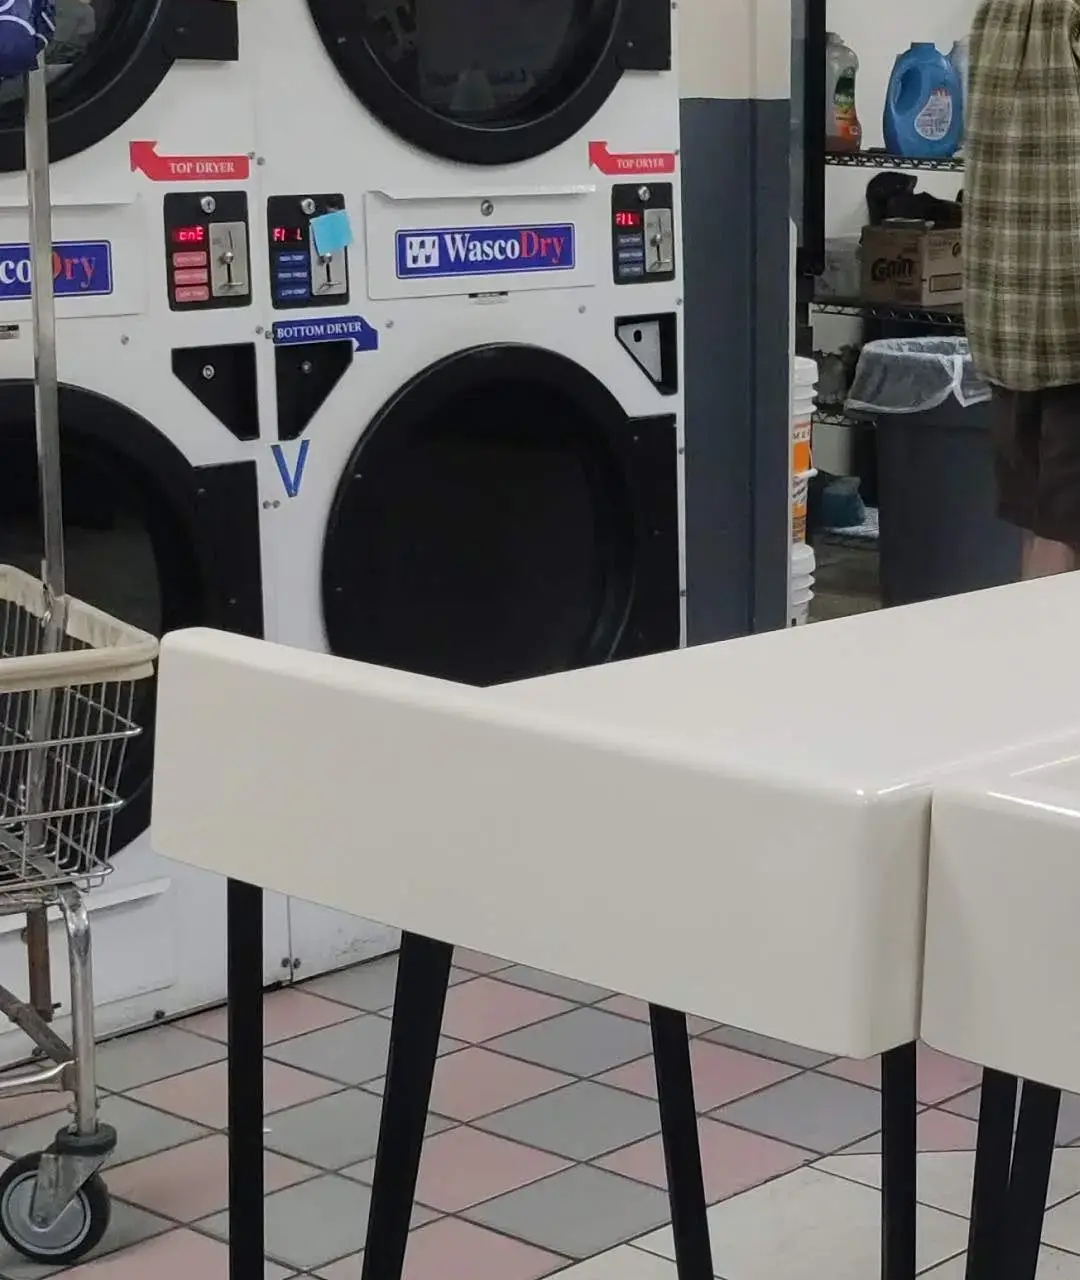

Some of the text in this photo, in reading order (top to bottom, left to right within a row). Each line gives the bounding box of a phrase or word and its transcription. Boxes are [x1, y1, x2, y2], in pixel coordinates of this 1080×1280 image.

[170, 161, 236, 174] TOP DRYER
[443, 231, 566, 263] WascoDry
[277, 322, 362, 339] BOTTOM DRYER
[270, 439, 311, 498] V
